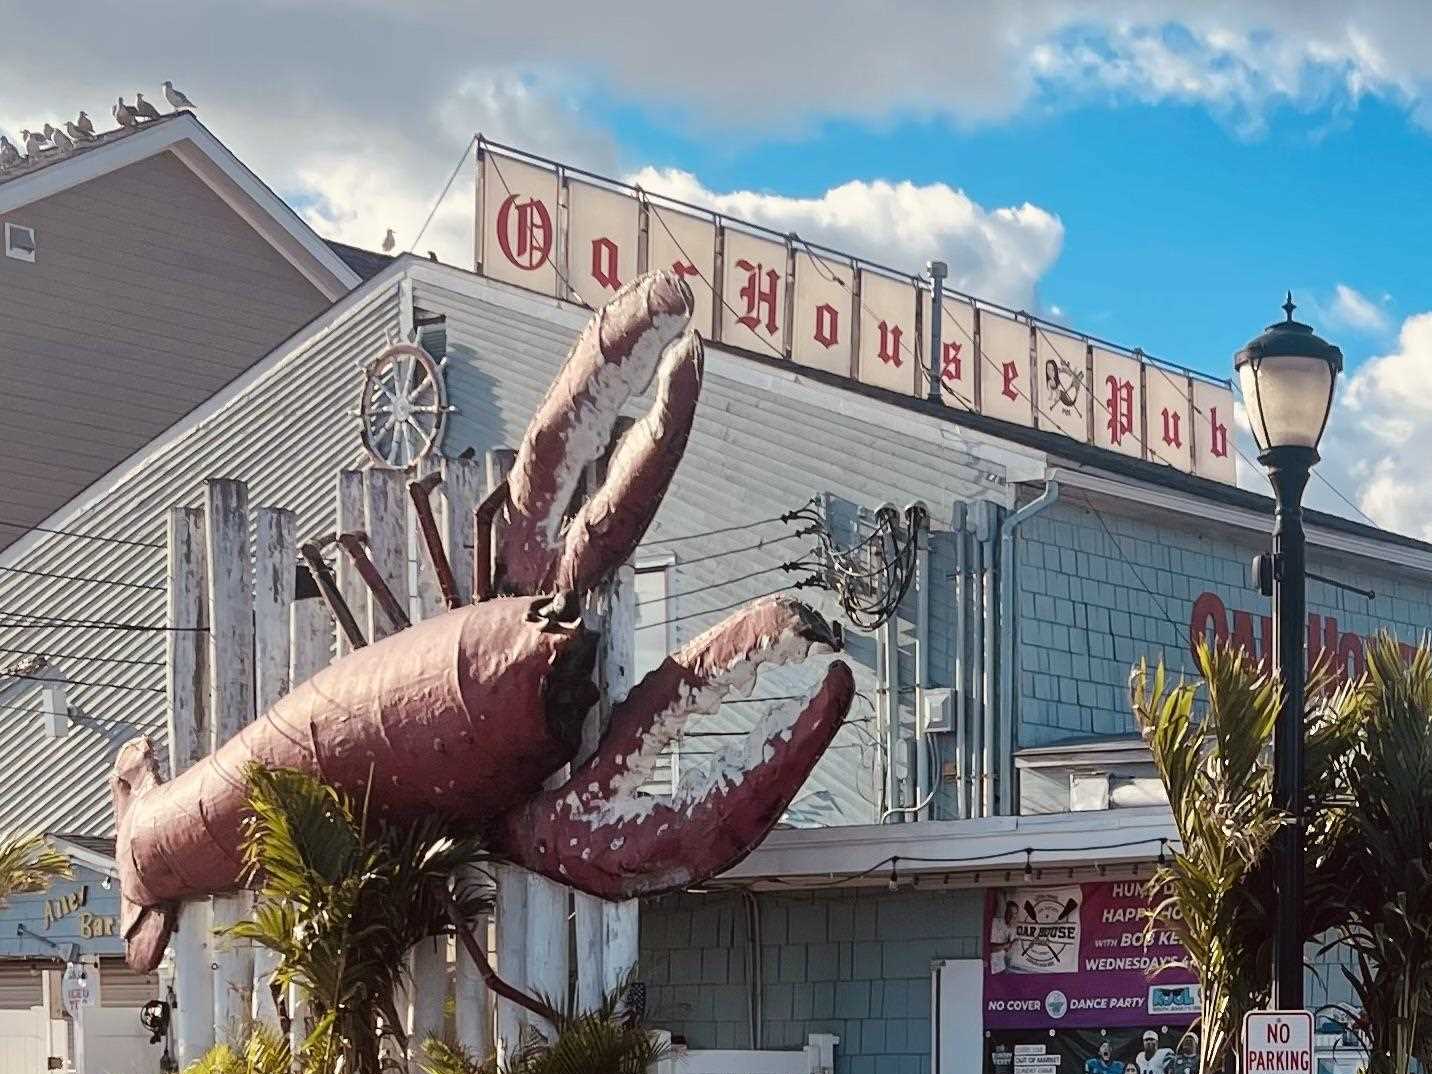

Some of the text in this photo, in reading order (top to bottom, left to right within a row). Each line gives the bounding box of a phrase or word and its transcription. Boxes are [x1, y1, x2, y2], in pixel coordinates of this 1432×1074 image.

[736, 258, 1020, 401] House
[1105, 374, 1228, 459] Pub
[1039, 926, 1076, 940] HOUSE
[988, 1000, 1041, 1011] NO COVER
[1070, 997, 1145, 1010] DANCE PARTY
[1267, 1023, 1291, 1044] NO
[1248, 1050, 1310, 1071] PARKING
